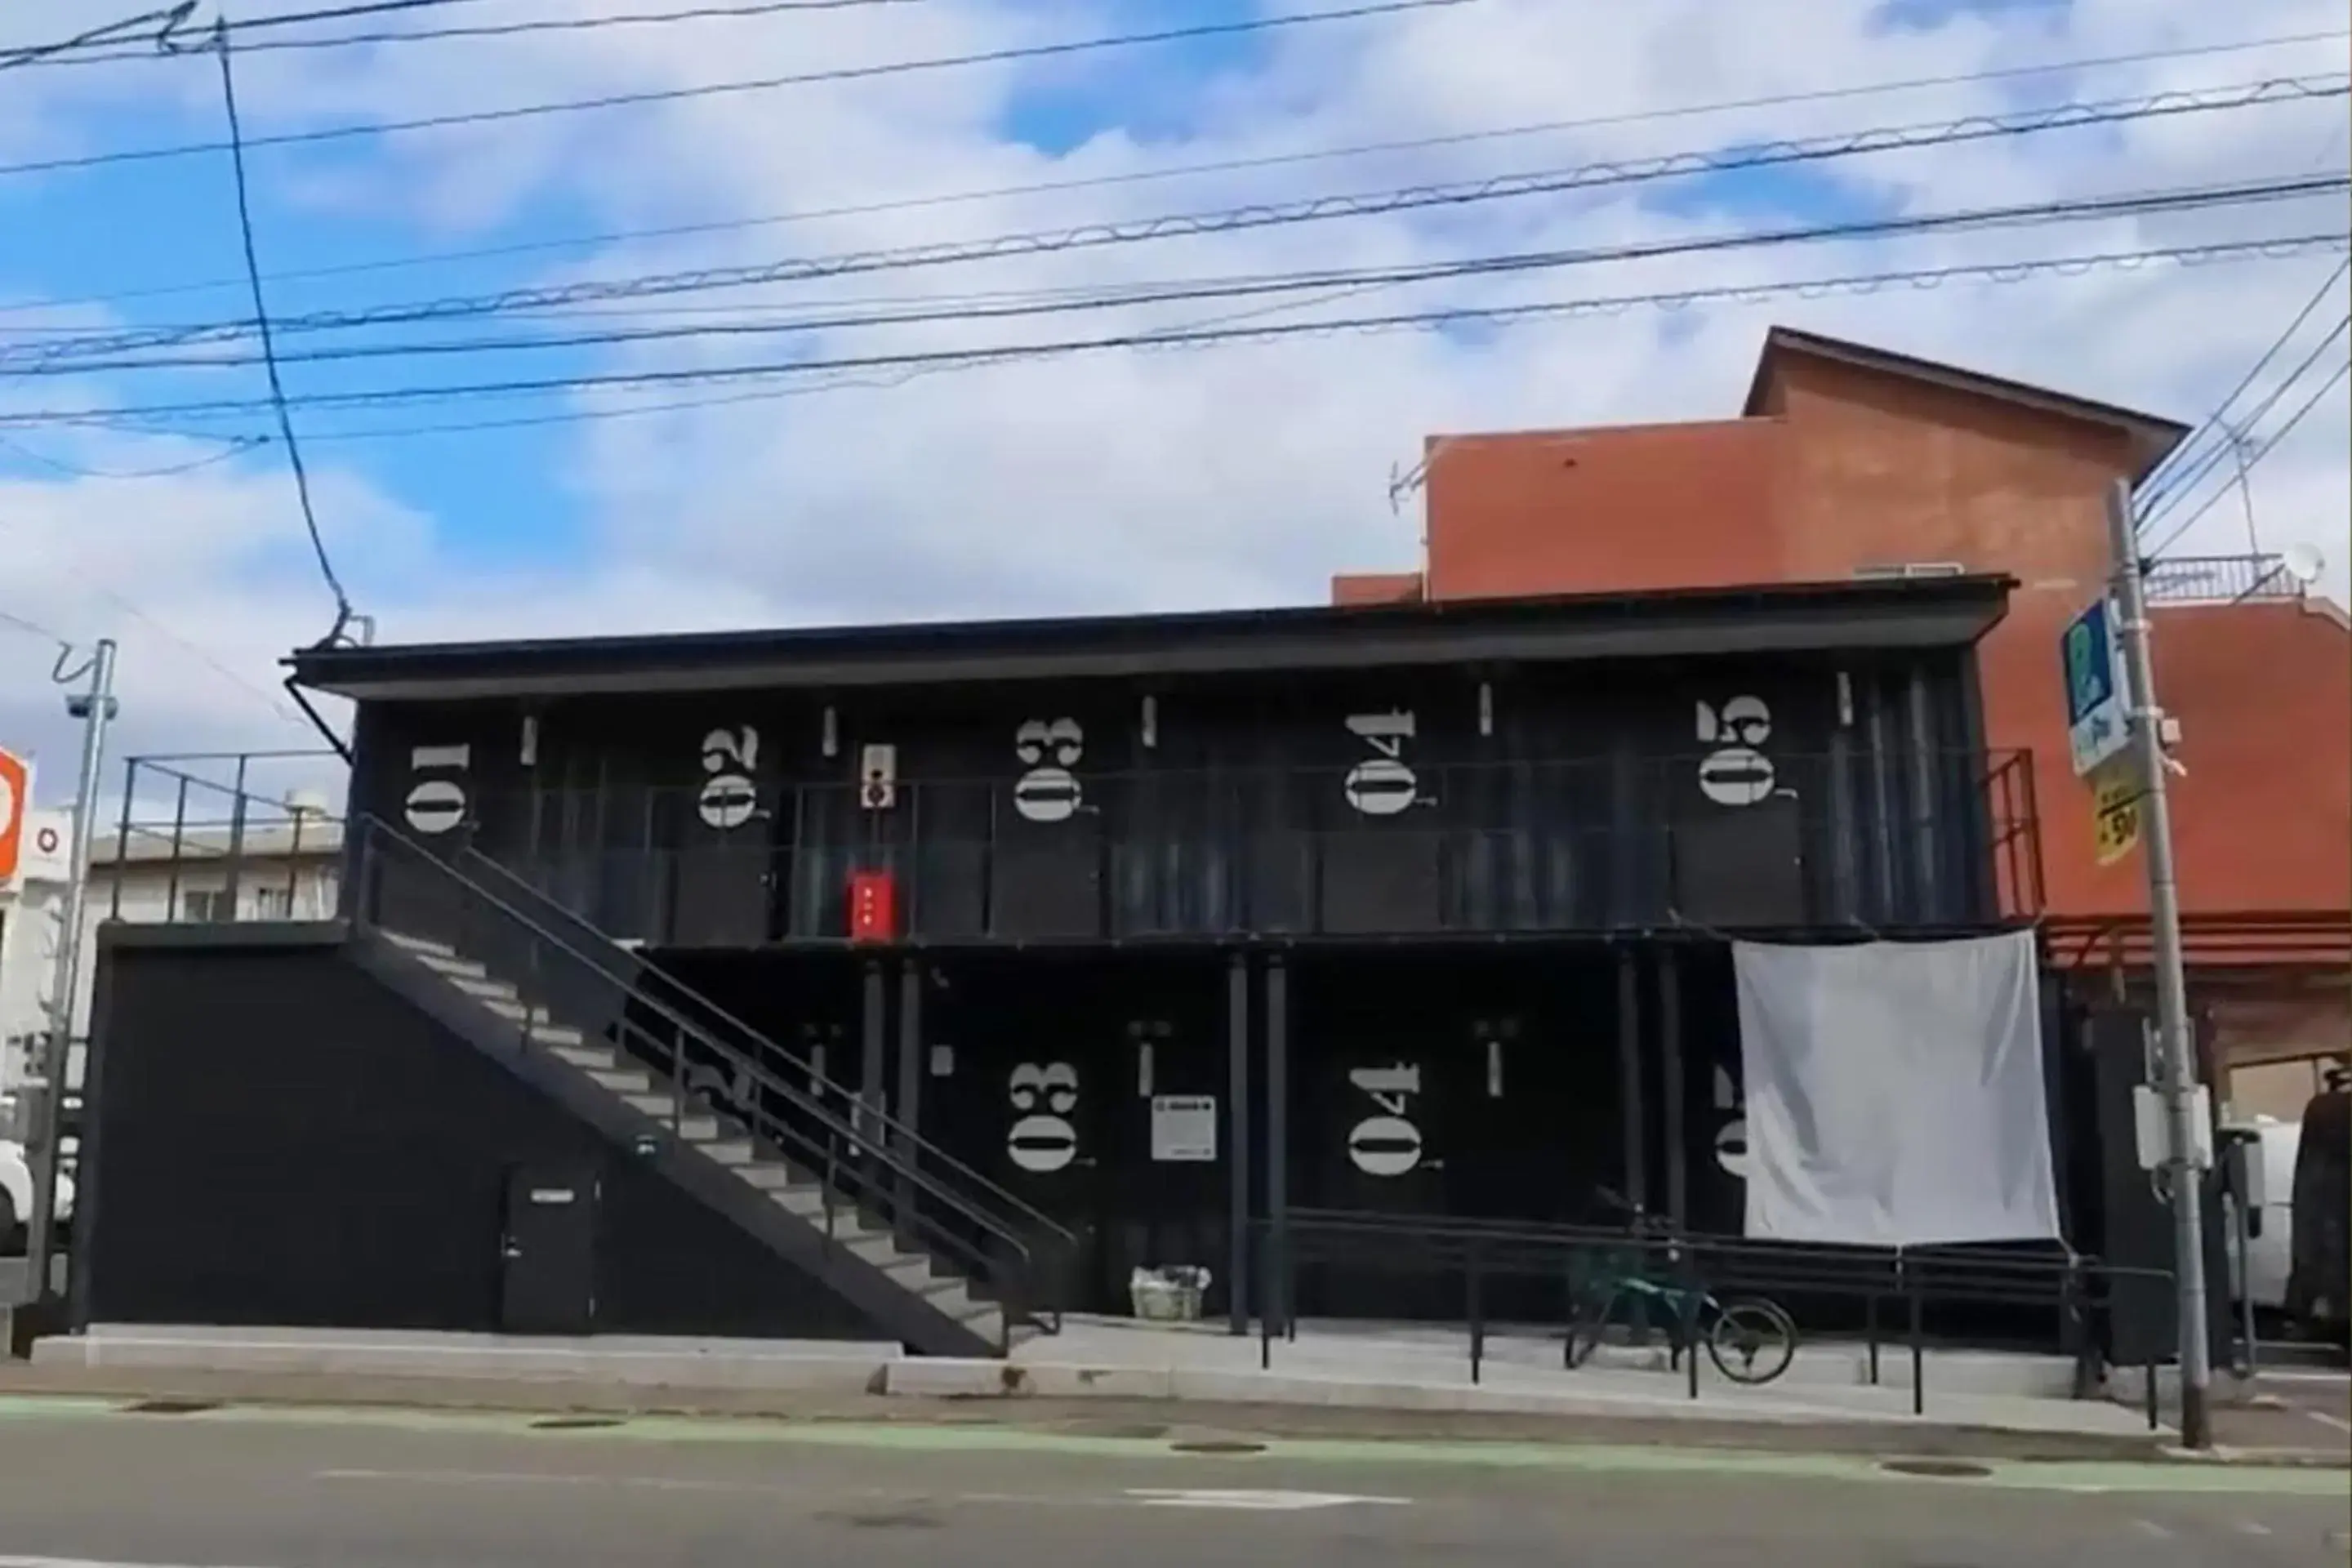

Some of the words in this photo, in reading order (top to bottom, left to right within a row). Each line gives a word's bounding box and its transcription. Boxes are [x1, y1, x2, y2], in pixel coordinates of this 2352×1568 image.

[405, 744, 470, 833] 01
[699, 725, 759, 827] 02
[1014, 717, 1083, 822] 03
[1344, 708, 1417, 814] 04
[1696, 696, 1775, 805] 05
[1008, 1062, 1077, 1171] 03
[1348, 1062, 1421, 1176] 04
